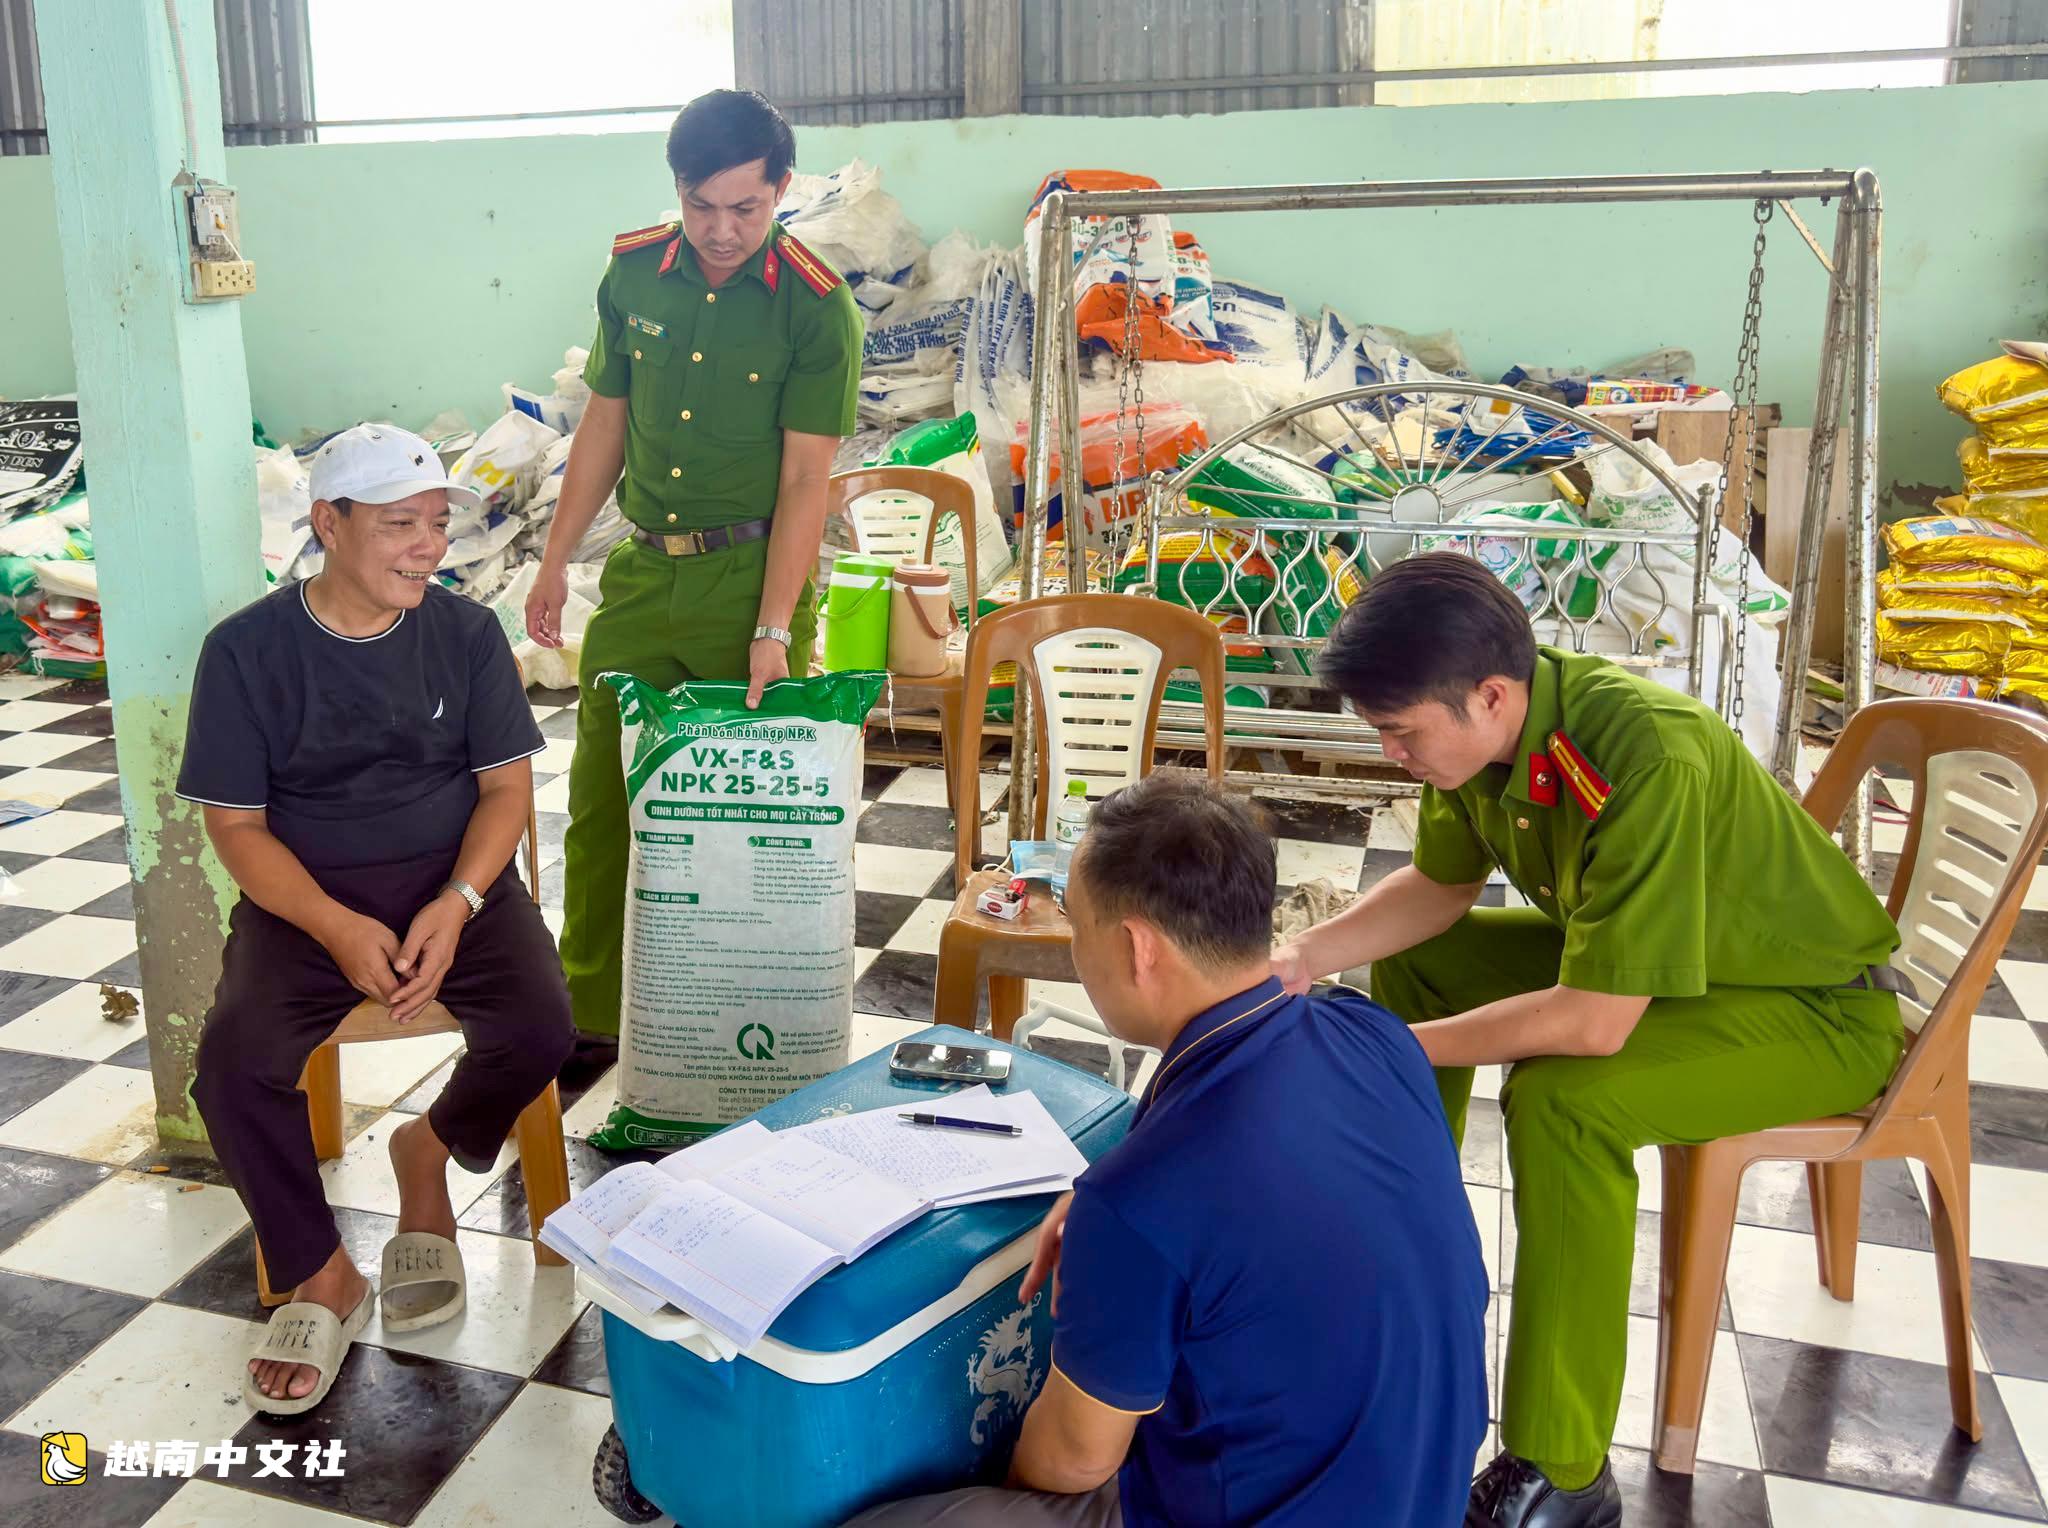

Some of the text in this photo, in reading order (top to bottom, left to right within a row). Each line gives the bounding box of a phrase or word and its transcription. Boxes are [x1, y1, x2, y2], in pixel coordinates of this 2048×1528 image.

[678, 722, 708, 738] Phân
[711, 725, 733, 740] bón
[762, 727, 785, 744] hợp
[786, 725, 817, 742] NPK
[690, 747, 796, 770] VX-F&S
[661, 771, 830, 797] NPK 25-25-5
[650, 805, 673, 817] DINH
[706, 805, 724, 818] TỐT
[724, 806, 748, 819] NHẤT
[750, 809, 769, 820] CHO
[770, 810, 788, 822] MỌI
[789, 808, 809, 822] CÂY
